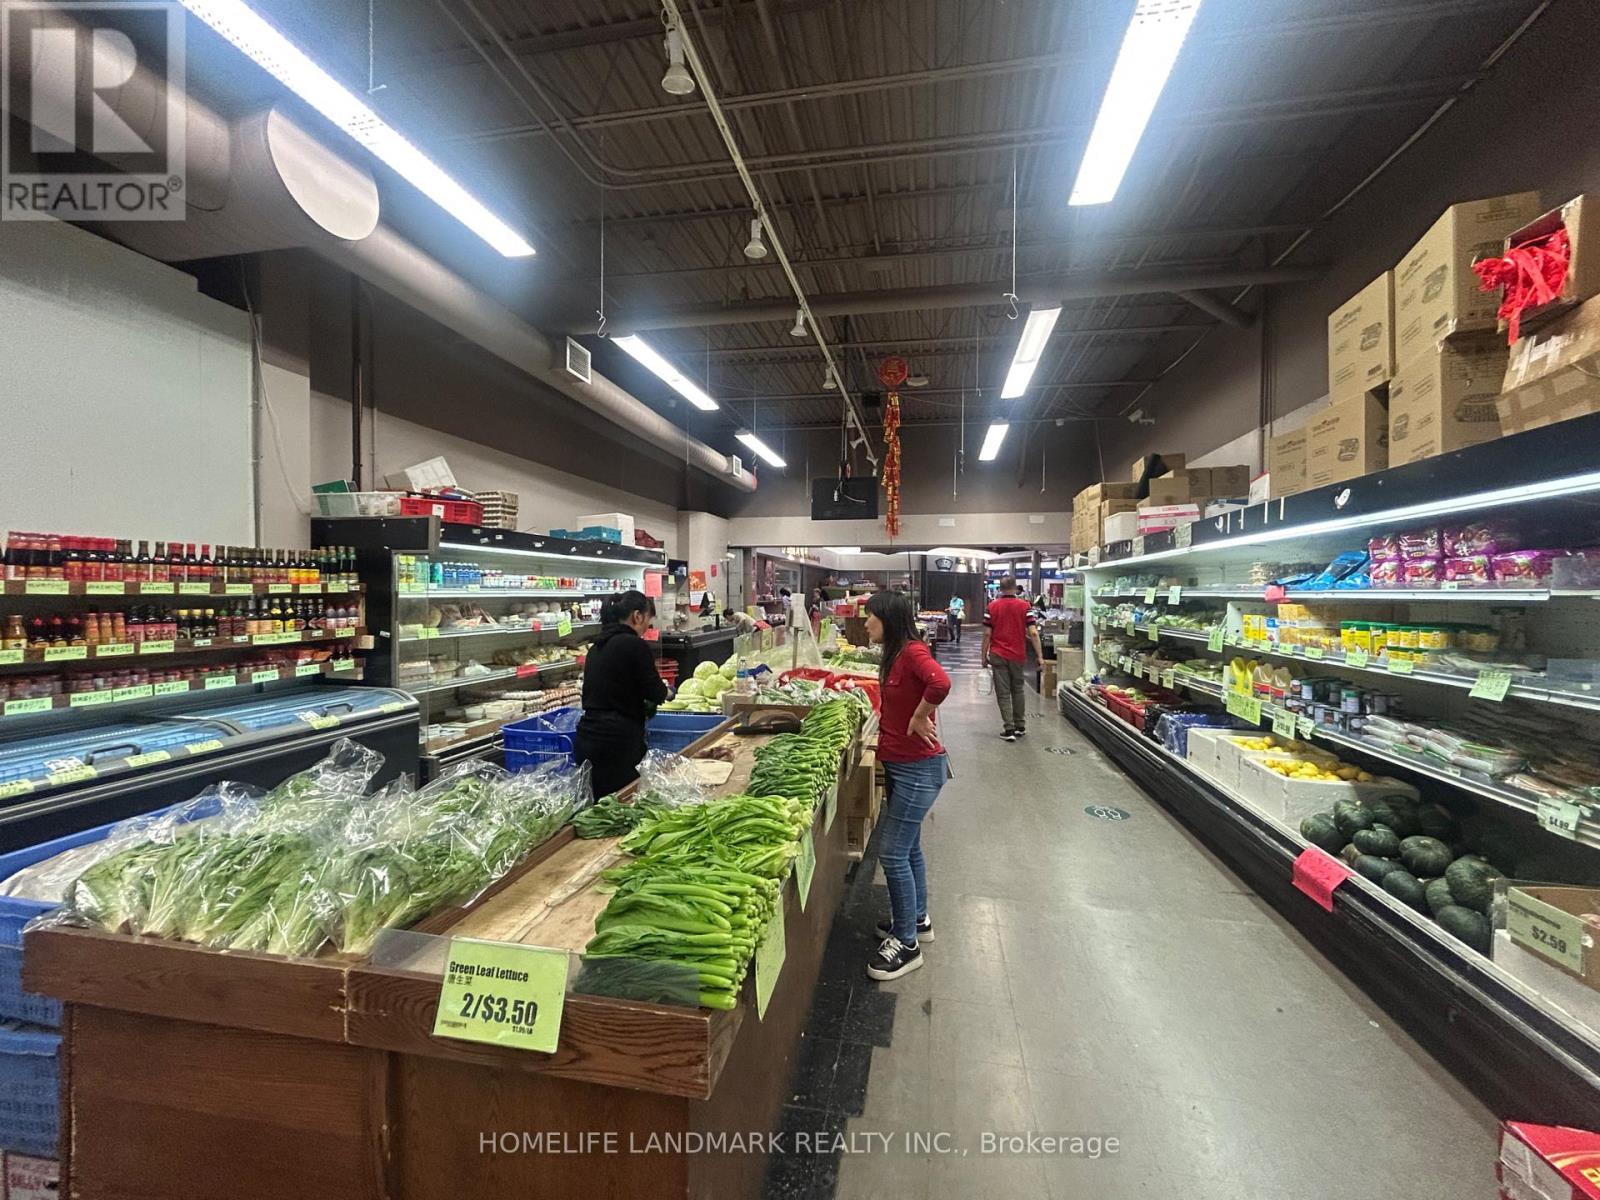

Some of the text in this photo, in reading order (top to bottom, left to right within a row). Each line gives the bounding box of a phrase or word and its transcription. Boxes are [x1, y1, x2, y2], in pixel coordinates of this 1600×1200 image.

[1531, 925, 1567, 954] $2.59
[449, 961, 529, 983] Green Leaf Lettuce
[460, 992, 538, 1027] 2/$3.50
